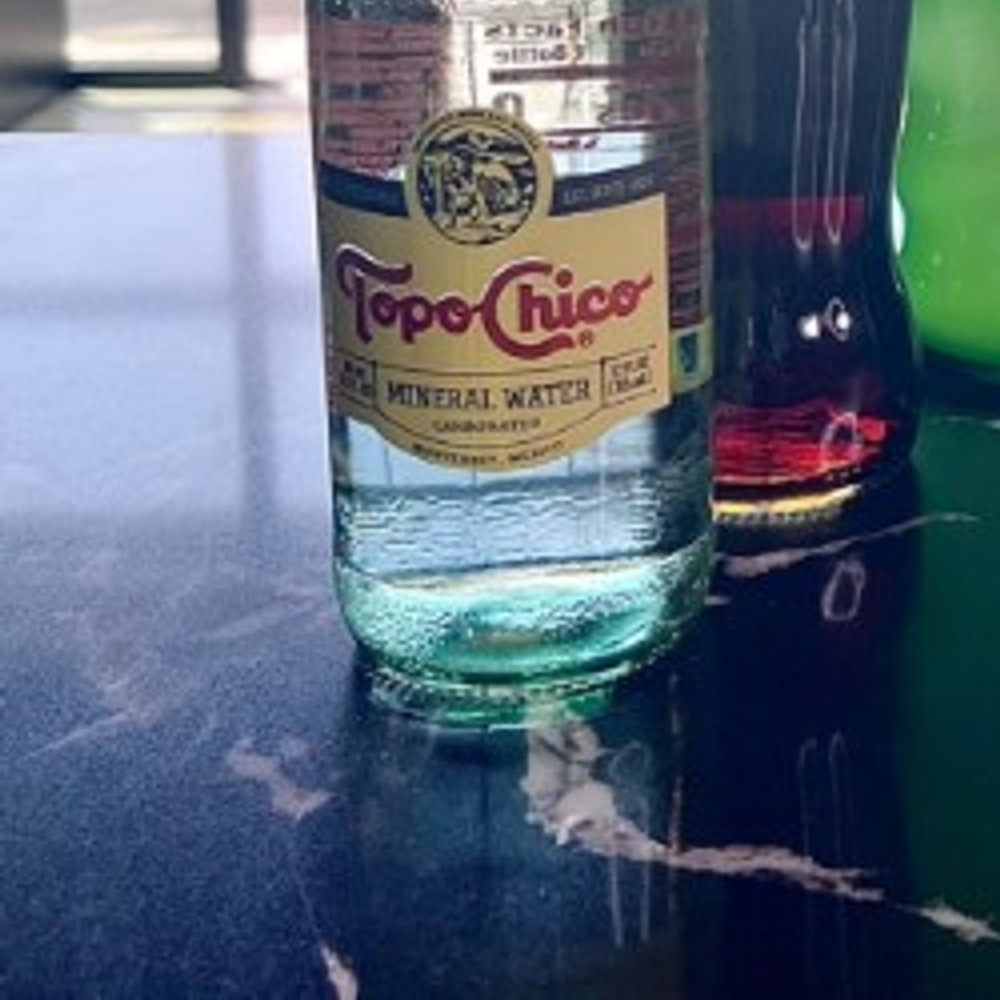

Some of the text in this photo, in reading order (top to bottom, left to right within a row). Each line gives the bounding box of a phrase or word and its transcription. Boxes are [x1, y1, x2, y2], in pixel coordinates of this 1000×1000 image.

[335, 244, 654, 360] Topo Chico
[386, 377, 591, 410] MINERAL WATER
